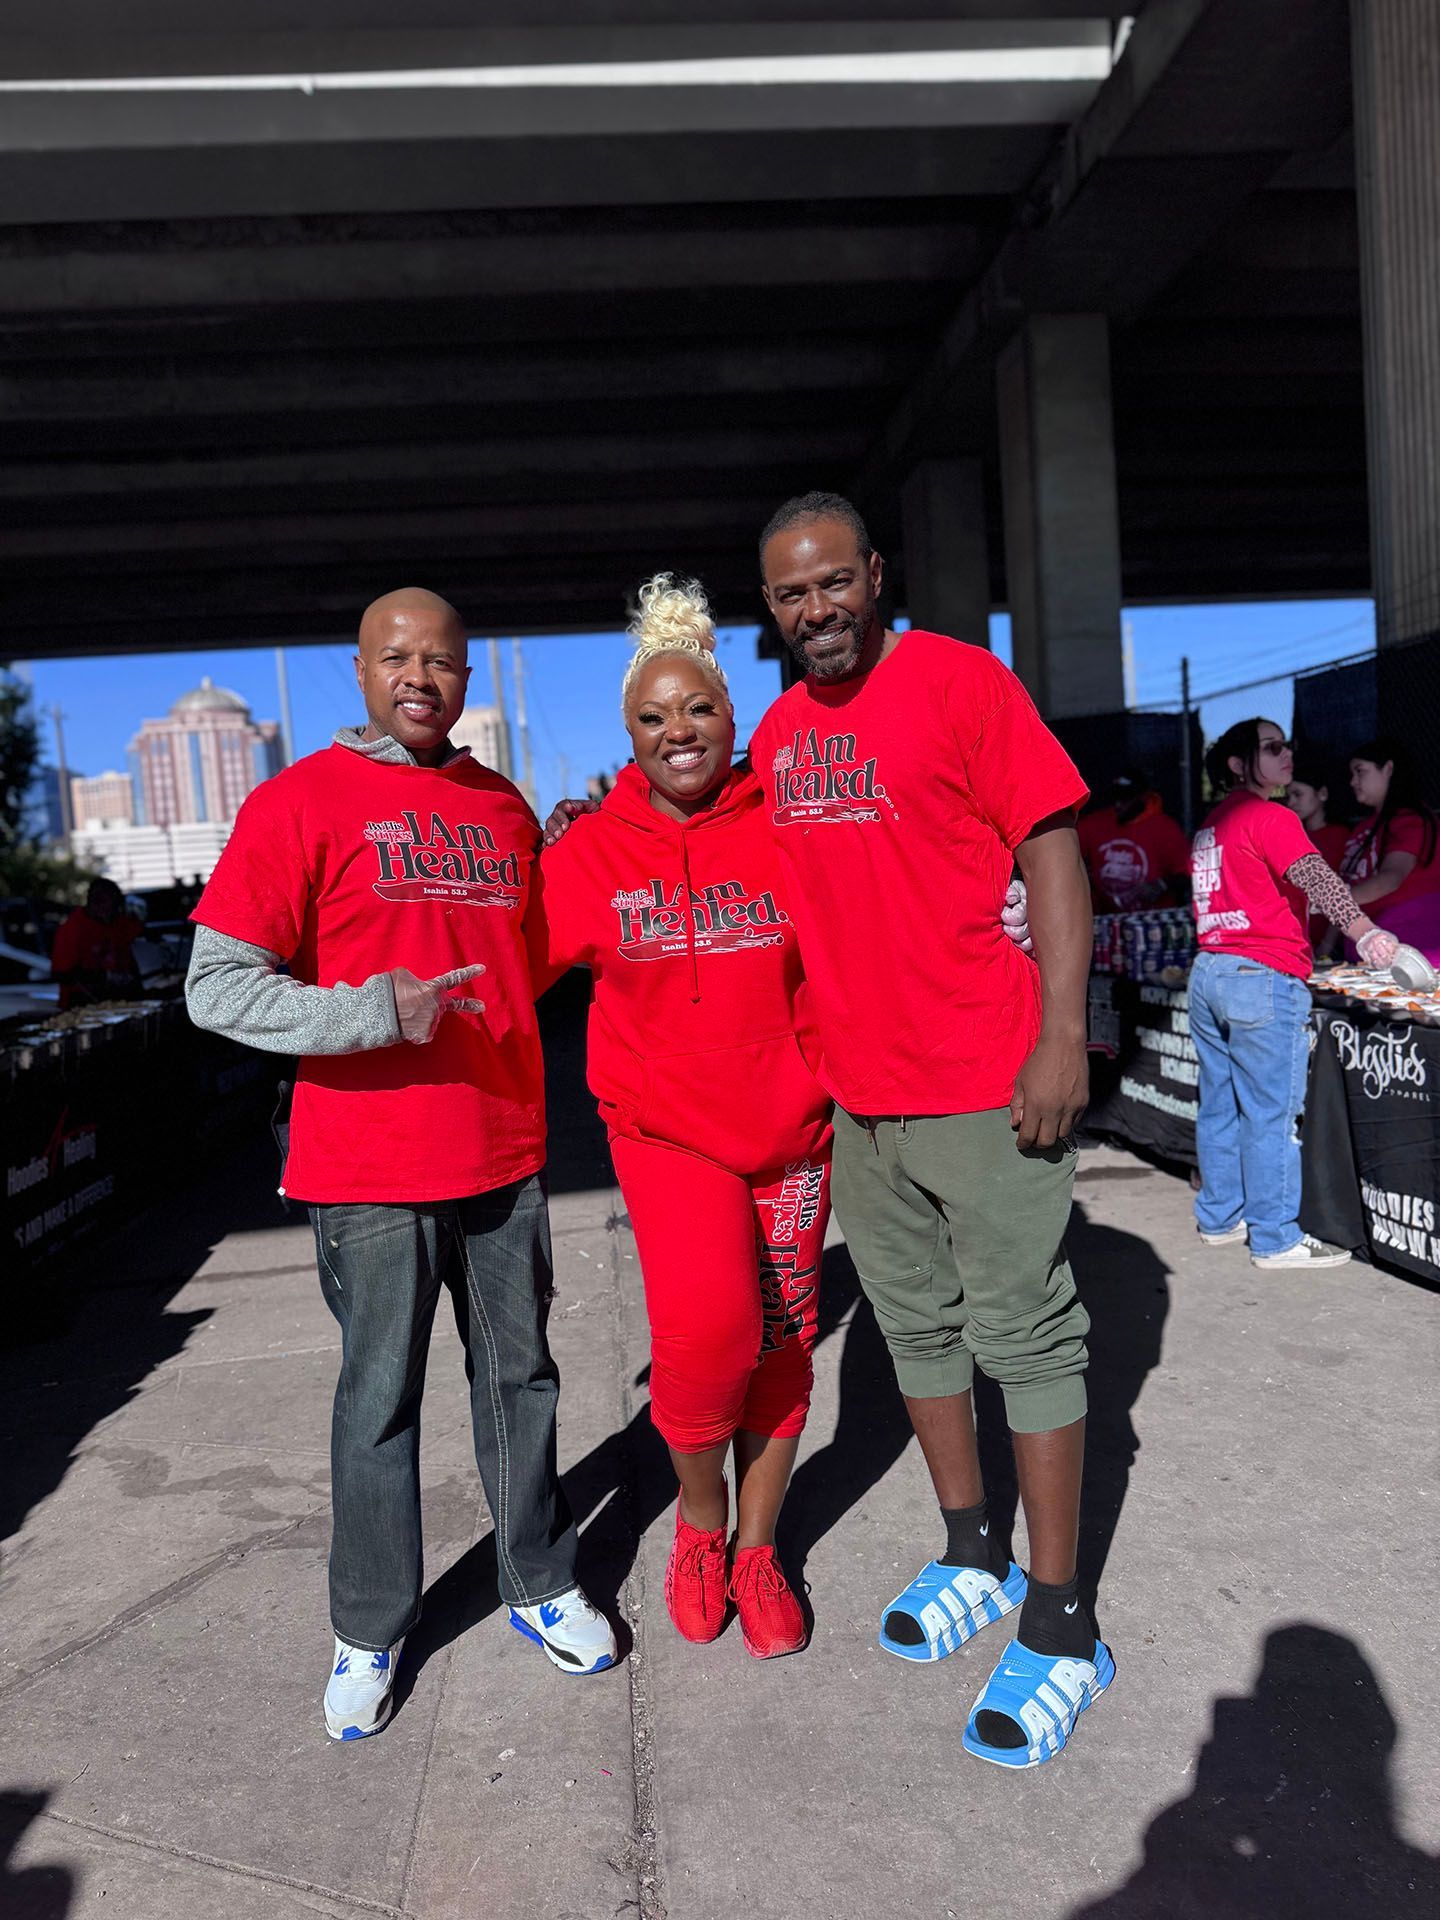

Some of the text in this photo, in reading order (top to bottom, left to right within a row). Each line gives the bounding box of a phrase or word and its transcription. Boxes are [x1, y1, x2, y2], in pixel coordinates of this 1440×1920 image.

[790, 730, 805, 770] I
[801, 727, 857, 767] Am
[401, 810, 498, 852] I Am
[423, 887, 468, 897] Isahia 53.5
[649, 879, 748, 910] I Am
[797, 1163, 825, 1230] By His
[920, 1569, 1014, 1660] AIR
[1020, 1659, 1103, 1760] AIR
